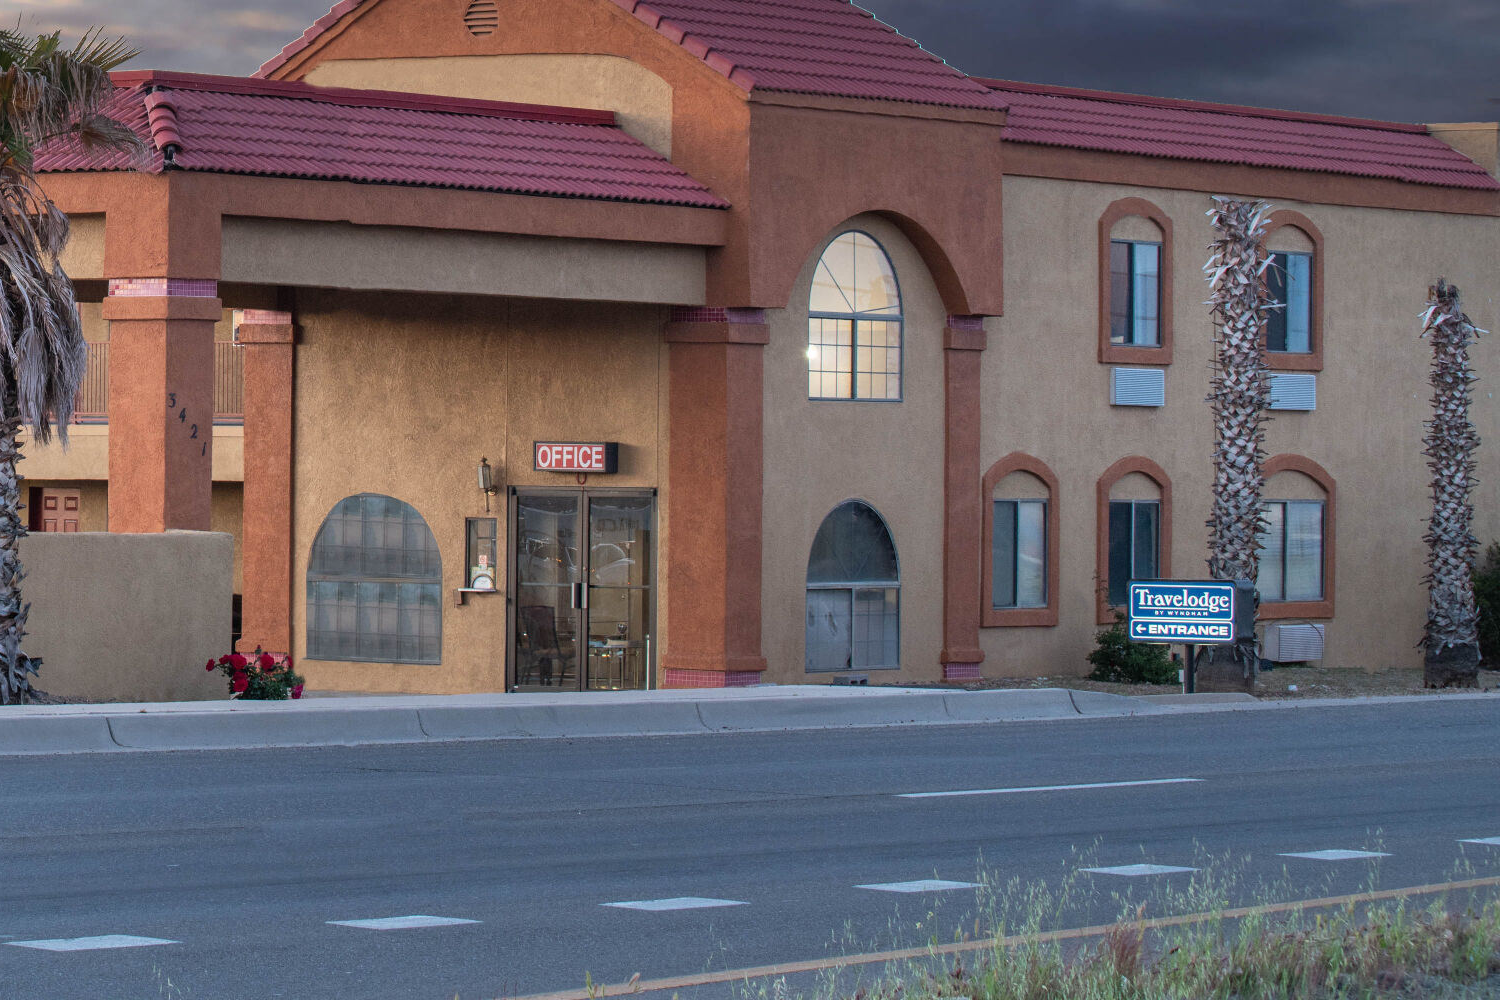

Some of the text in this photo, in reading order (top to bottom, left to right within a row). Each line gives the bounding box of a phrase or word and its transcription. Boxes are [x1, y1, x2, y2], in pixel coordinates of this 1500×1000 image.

[537, 445, 604, 468] OFFICE
[1135, 589, 1229, 613] Travelodge
[1148, 624, 1229, 636] ENTRANCE
